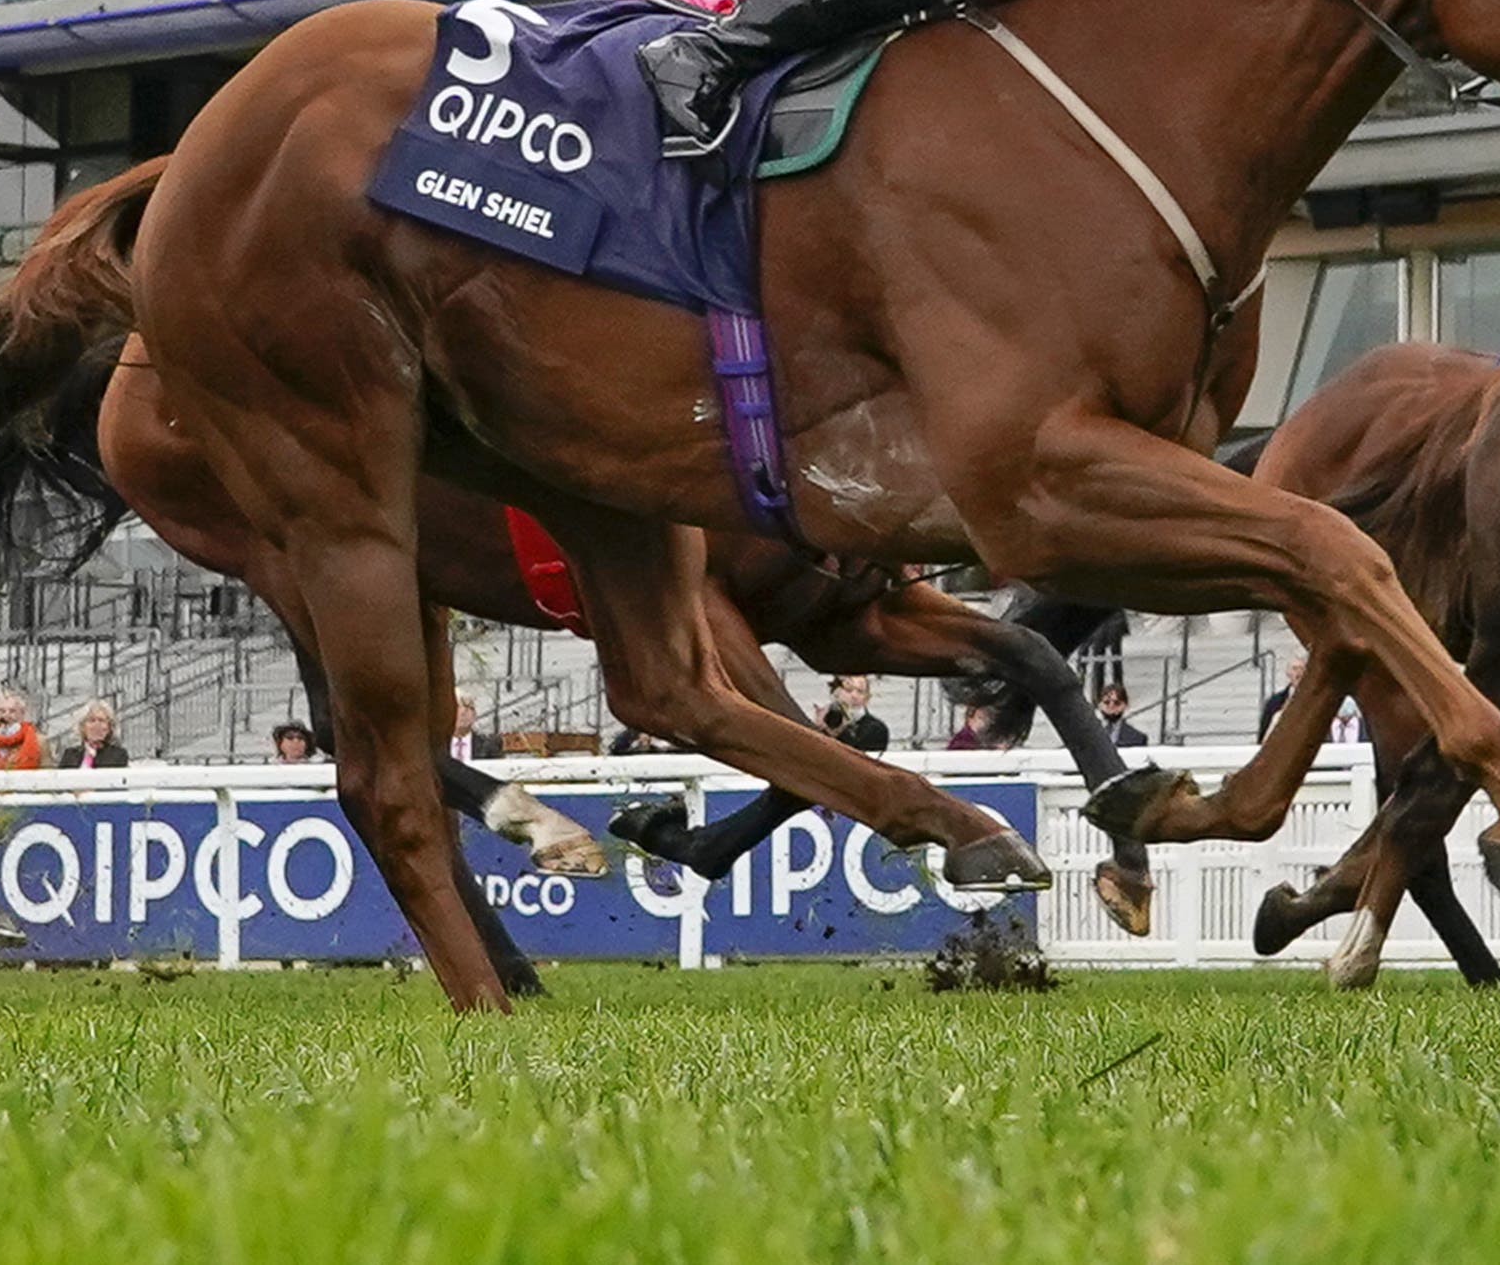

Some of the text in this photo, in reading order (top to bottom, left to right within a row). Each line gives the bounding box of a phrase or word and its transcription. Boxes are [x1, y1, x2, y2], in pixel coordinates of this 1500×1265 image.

[428, 85, 593, 173] QIPCO
[415, 170, 554, 239] GLEN SHIEL
[0, 817, 354, 927] QIPCO
[474, 874, 576, 916] PCO
